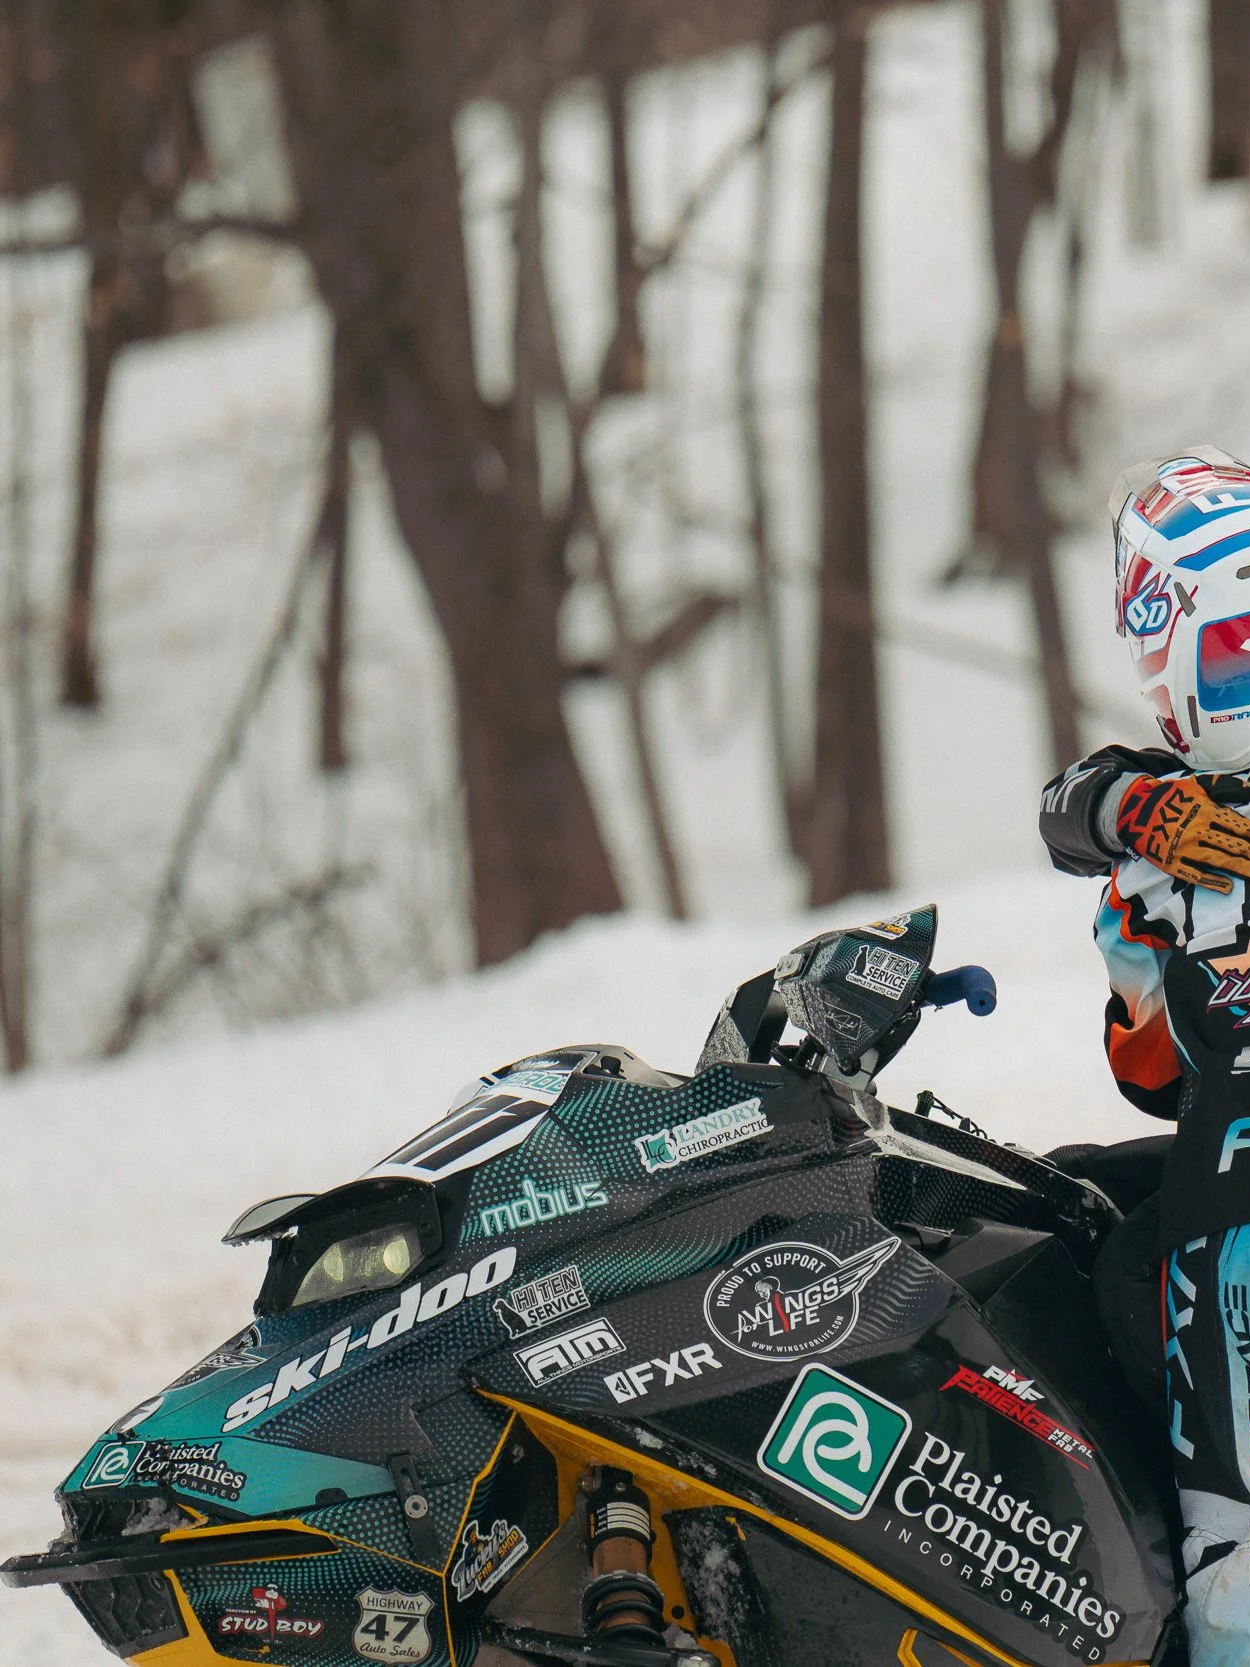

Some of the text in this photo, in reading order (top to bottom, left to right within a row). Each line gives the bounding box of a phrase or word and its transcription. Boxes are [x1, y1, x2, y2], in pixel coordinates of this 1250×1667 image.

[1146, 787, 1194, 864] FXR
[1166, 825, 1184, 865] RACE
[866, 966, 908, 989] SERVICE
[869, 948, 917, 978] HI TEN
[846, 974, 900, 1000] COMPLETE AUTO CARE
[677, 1101, 757, 1144] LANDRY
[678, 1118, 770, 1158] CHIROPRACTIC
[481, 1180, 608, 1237] mobius
[512, 1271, 581, 1313] HI TEN
[717, 1252, 827, 1308] PROUD TO SUPPORT
[527, 1289, 588, 1324] SERVICE
[222, 1246, 517, 1433] ski-doo
[519, 1320, 620, 1381] ATM
[751, 1315, 845, 1353] WWW.WINGSFORLIFE.COM
[572, 1346, 622, 1368] MOTORSPORTS
[625, 1342, 724, 1396] FXR
[939, 1365, 1057, 1437] PATIENCE
[982, 1365, 1046, 1401] PMF
[1047, 1433, 1074, 1453] FAB
[1053, 1428, 1094, 1459] METAL
[908, 1431, 1083, 1564] Plaisted
[498, 1529, 519, 1558] SHOP
[894, 1475, 1121, 1639] Companies
[477, 1560, 494, 1585] FAB
[883, 1519, 1101, 1661] INCORPORATED
[366, 1596, 424, 1612] HIGHWAY
[221, 1616, 322, 1636] STUD BOY
[360, 1613, 421, 1644] 47
[359, 1641, 421, 1659] Auto Sales
